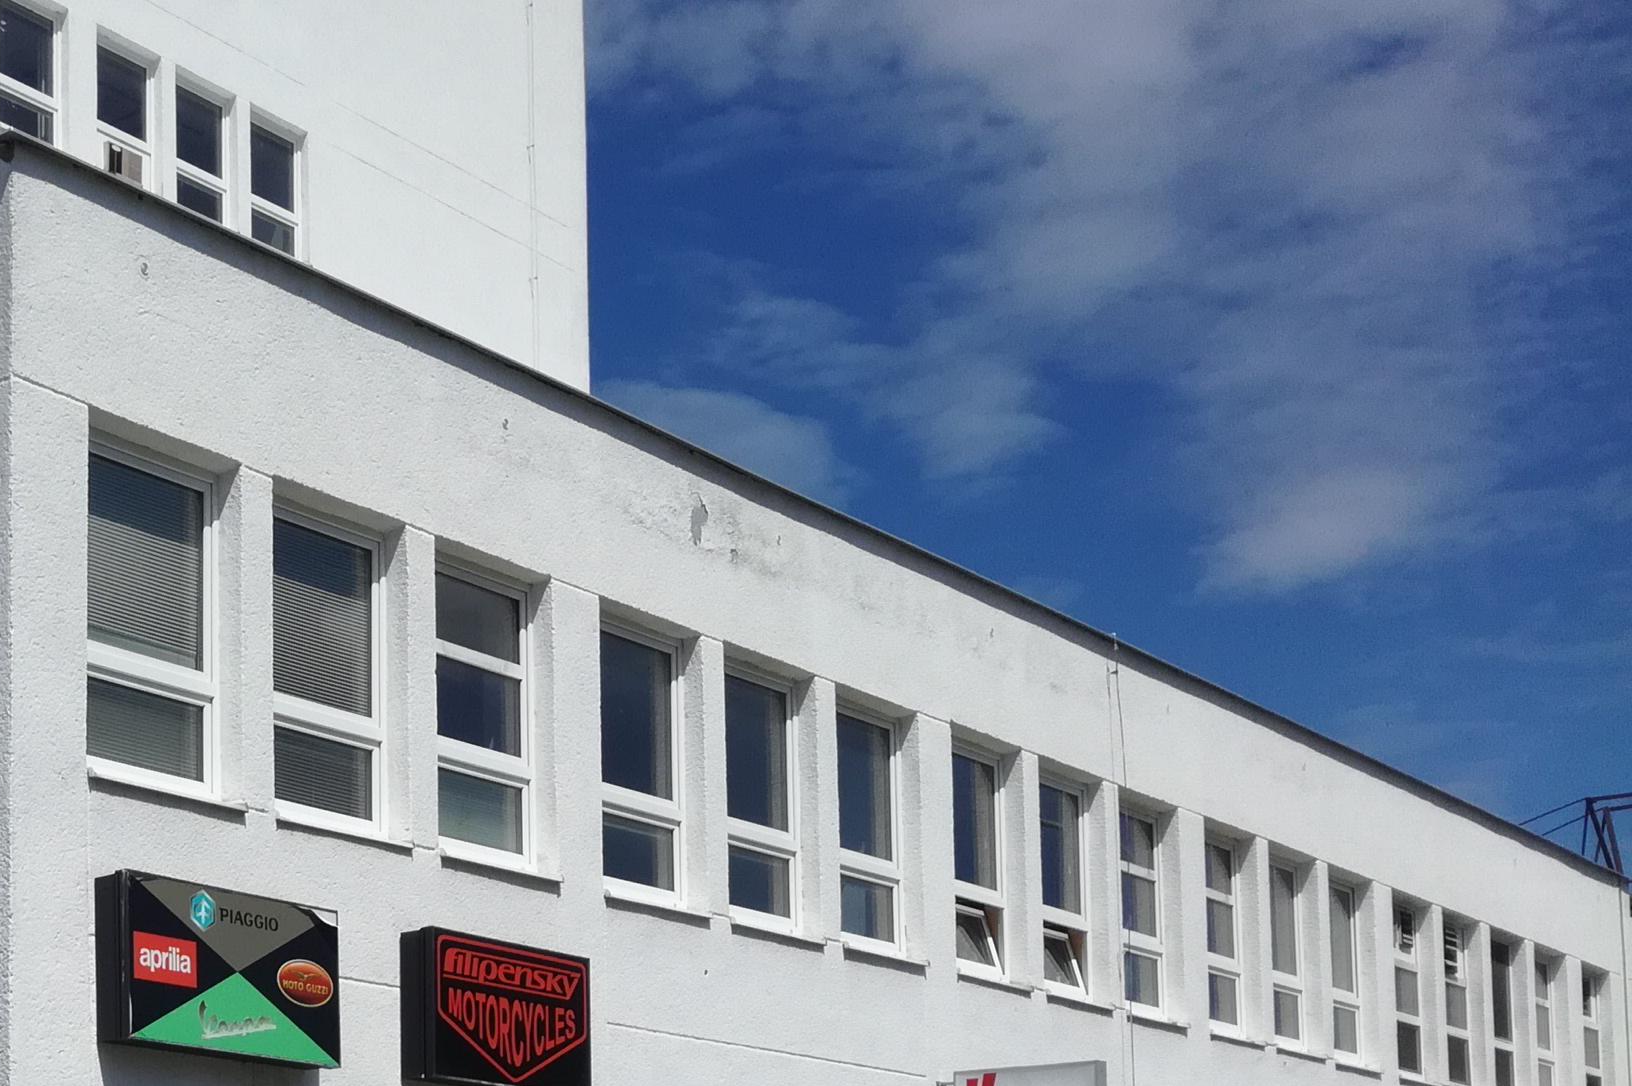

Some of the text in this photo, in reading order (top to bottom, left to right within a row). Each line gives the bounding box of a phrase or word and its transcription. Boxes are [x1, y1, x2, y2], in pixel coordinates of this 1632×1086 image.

[219, 907, 279, 932] PIAGGIO
[139, 946, 191, 974] aprilia
[282, 979, 329, 995] MOTO GUZZI
[448, 987, 576, 1067] MOTORCYCLES
